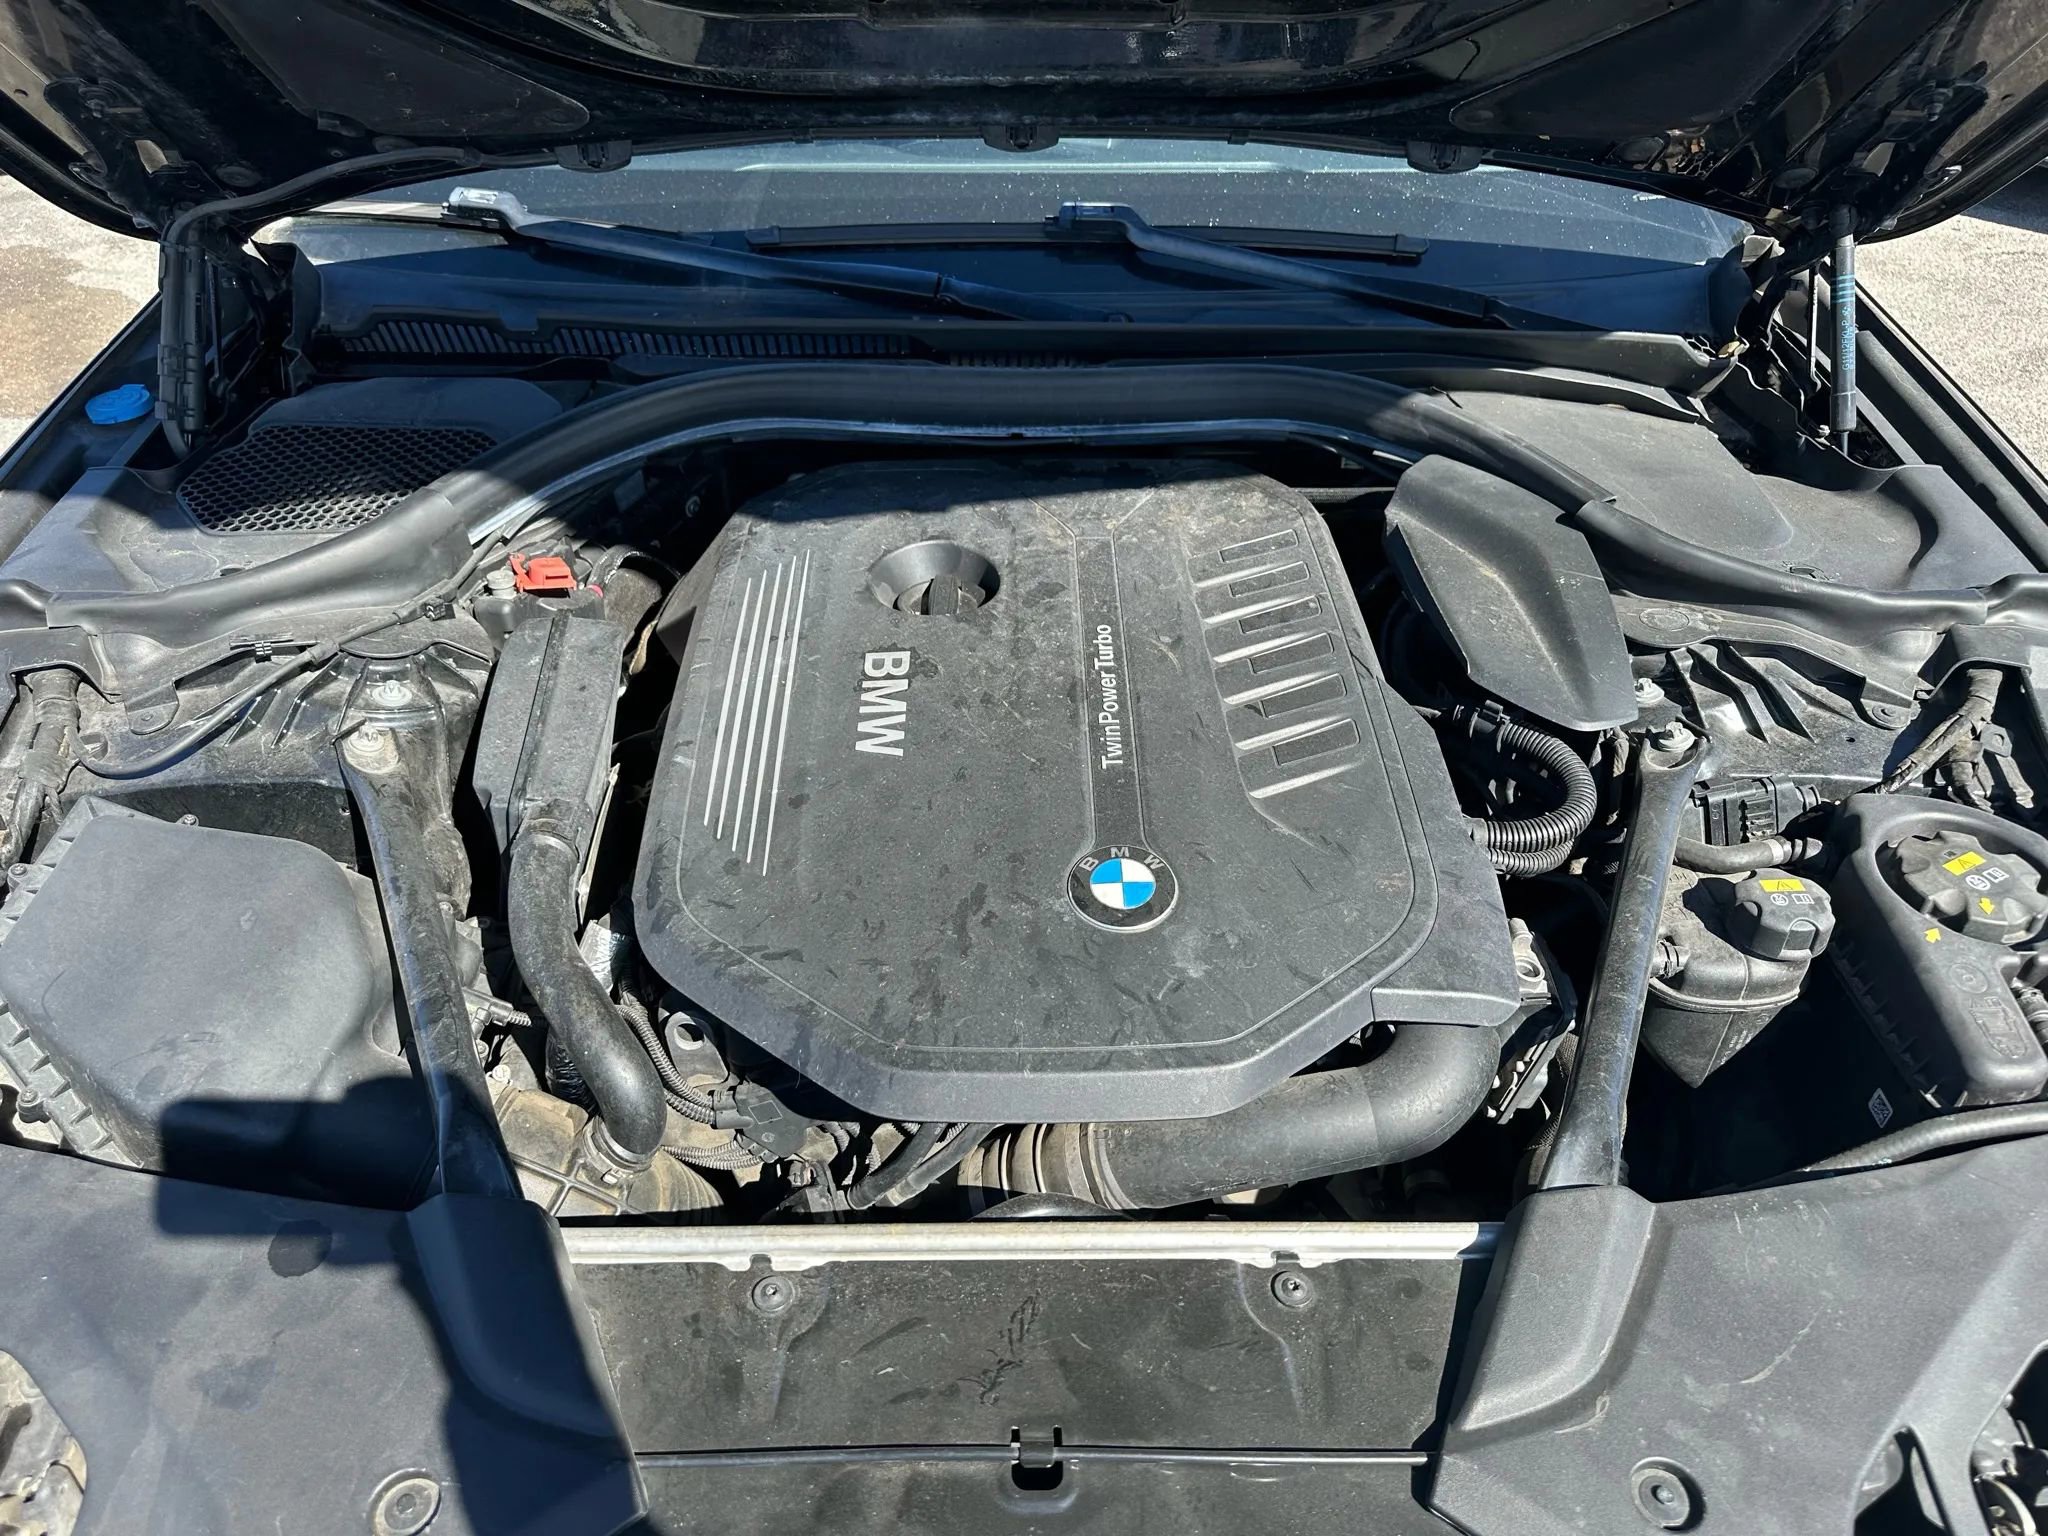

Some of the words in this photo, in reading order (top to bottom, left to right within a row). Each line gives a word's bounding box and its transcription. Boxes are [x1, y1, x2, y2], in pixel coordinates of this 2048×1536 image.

[1093, 625, 1115, 669] Turbo
[855, 651, 911, 756] BMW
[1099, 670, 1124, 769] TwinPower
[1079, 847, 1164, 871] BMW
